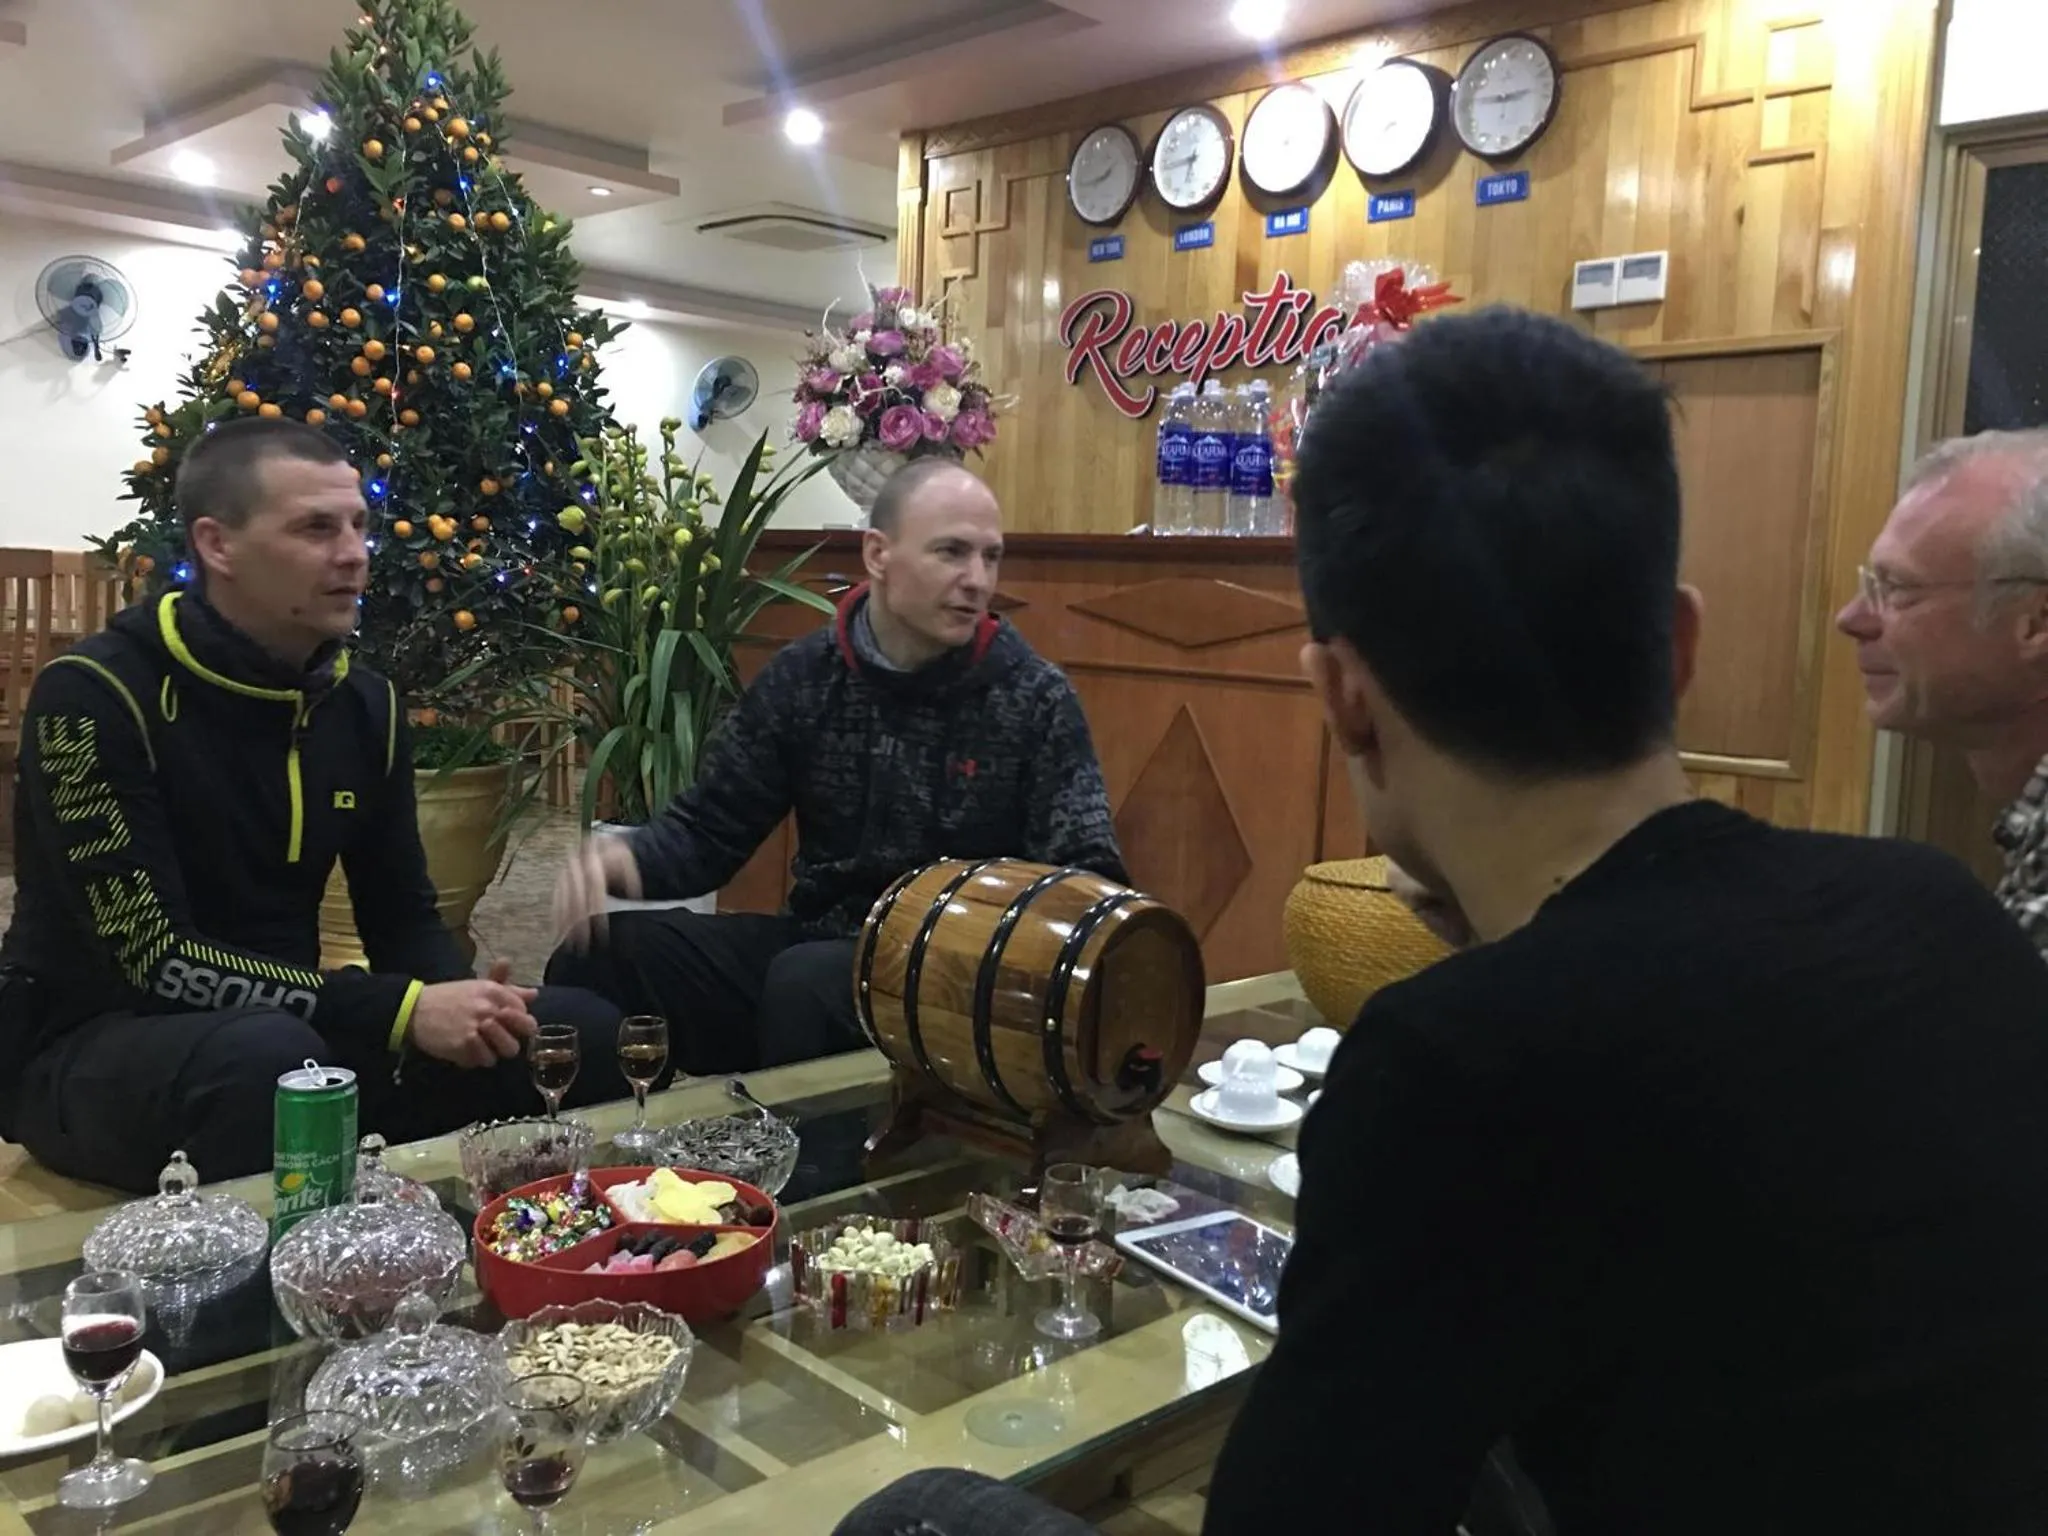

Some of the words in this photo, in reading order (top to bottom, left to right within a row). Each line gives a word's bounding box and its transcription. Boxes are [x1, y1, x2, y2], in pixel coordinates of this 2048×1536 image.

[1487, 178, 1518, 197] TOKYO
[1059, 270, 1347, 419] Receptio
[274, 1182, 323, 1219] prite
